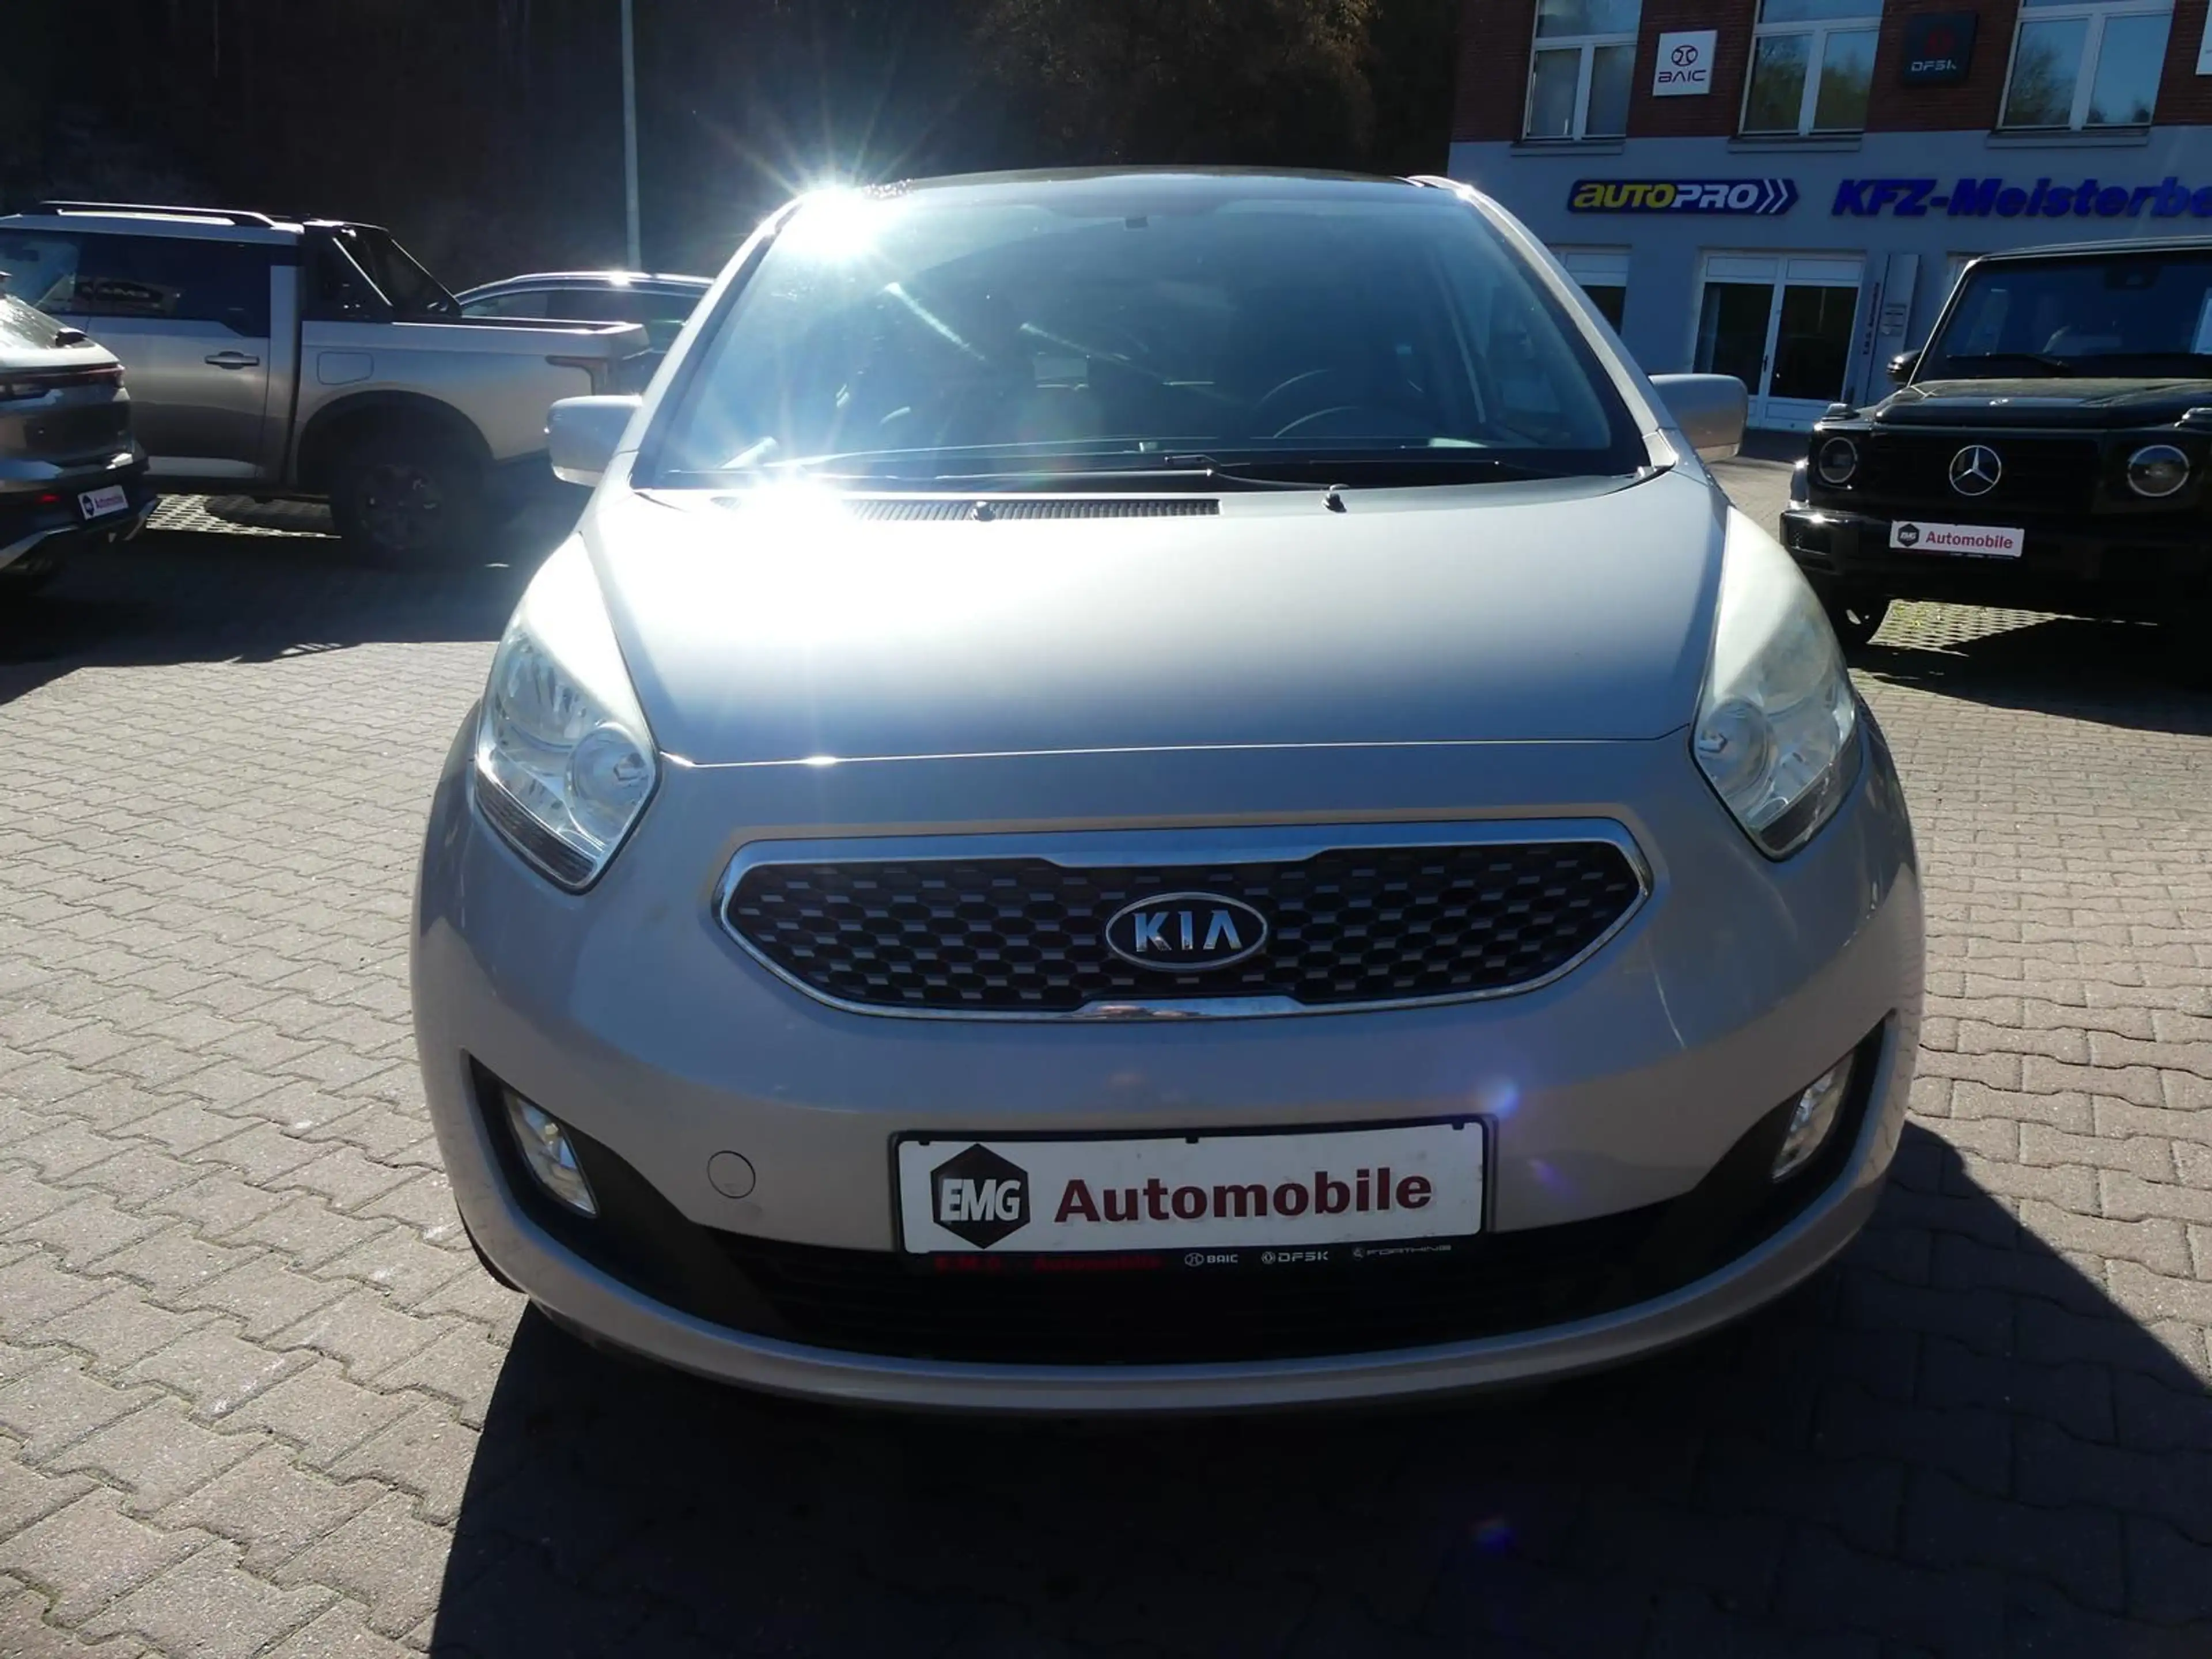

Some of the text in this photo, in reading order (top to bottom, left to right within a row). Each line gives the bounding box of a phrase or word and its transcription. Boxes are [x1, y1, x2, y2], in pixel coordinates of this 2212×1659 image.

[1911, 58, 1957, 72] DFSK
[1658, 69, 1706, 82] BAIC
[1926, 531, 2014, 549] Automobile
[1132, 910, 1243, 952] KIA
[939, 1166, 1433, 1224] EMG Automobile
[1207, 1253, 1238, 1264] BAIC
[1278, 1251, 1328, 1262] DFSK
